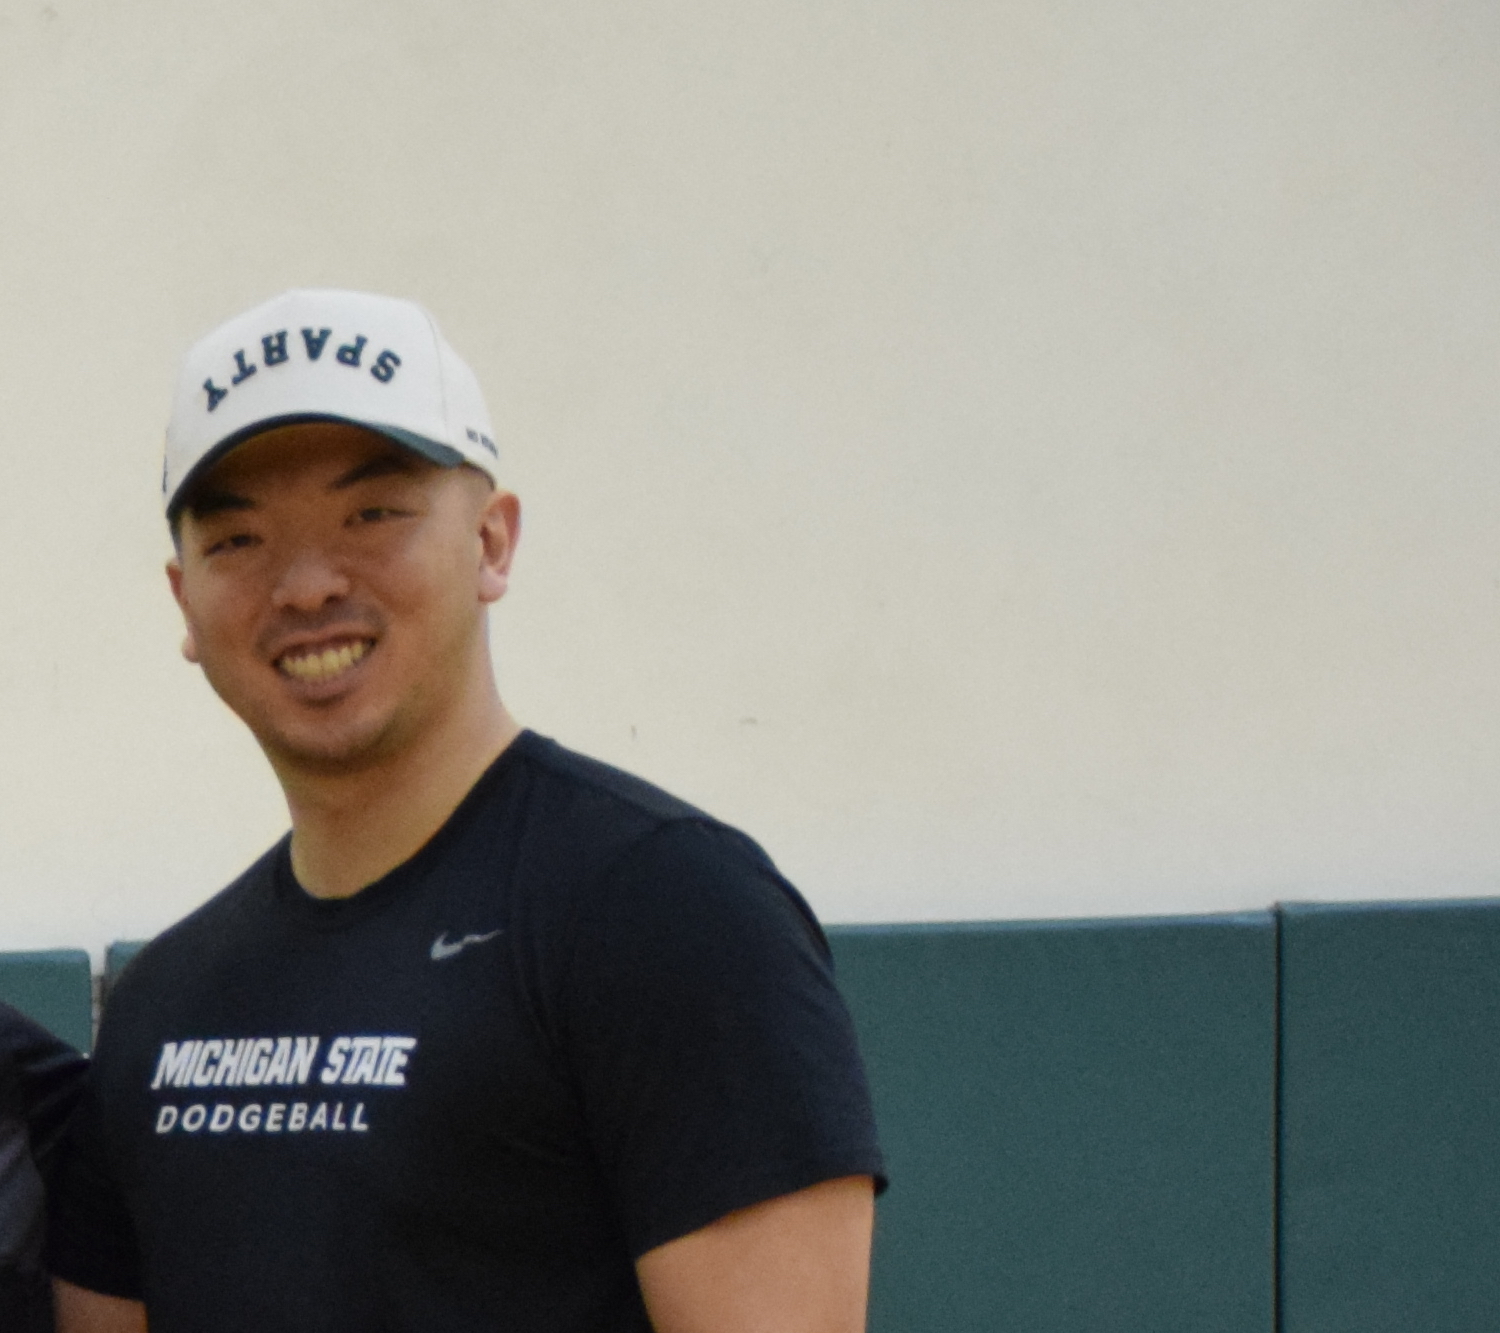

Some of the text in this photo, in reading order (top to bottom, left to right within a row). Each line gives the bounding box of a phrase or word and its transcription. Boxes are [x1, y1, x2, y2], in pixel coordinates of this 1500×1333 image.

[203, 327, 402, 413] SPARTY
[151, 1036, 417, 1090] MICHIGAN STATE
[156, 1103, 369, 1134] DODGEBALL
